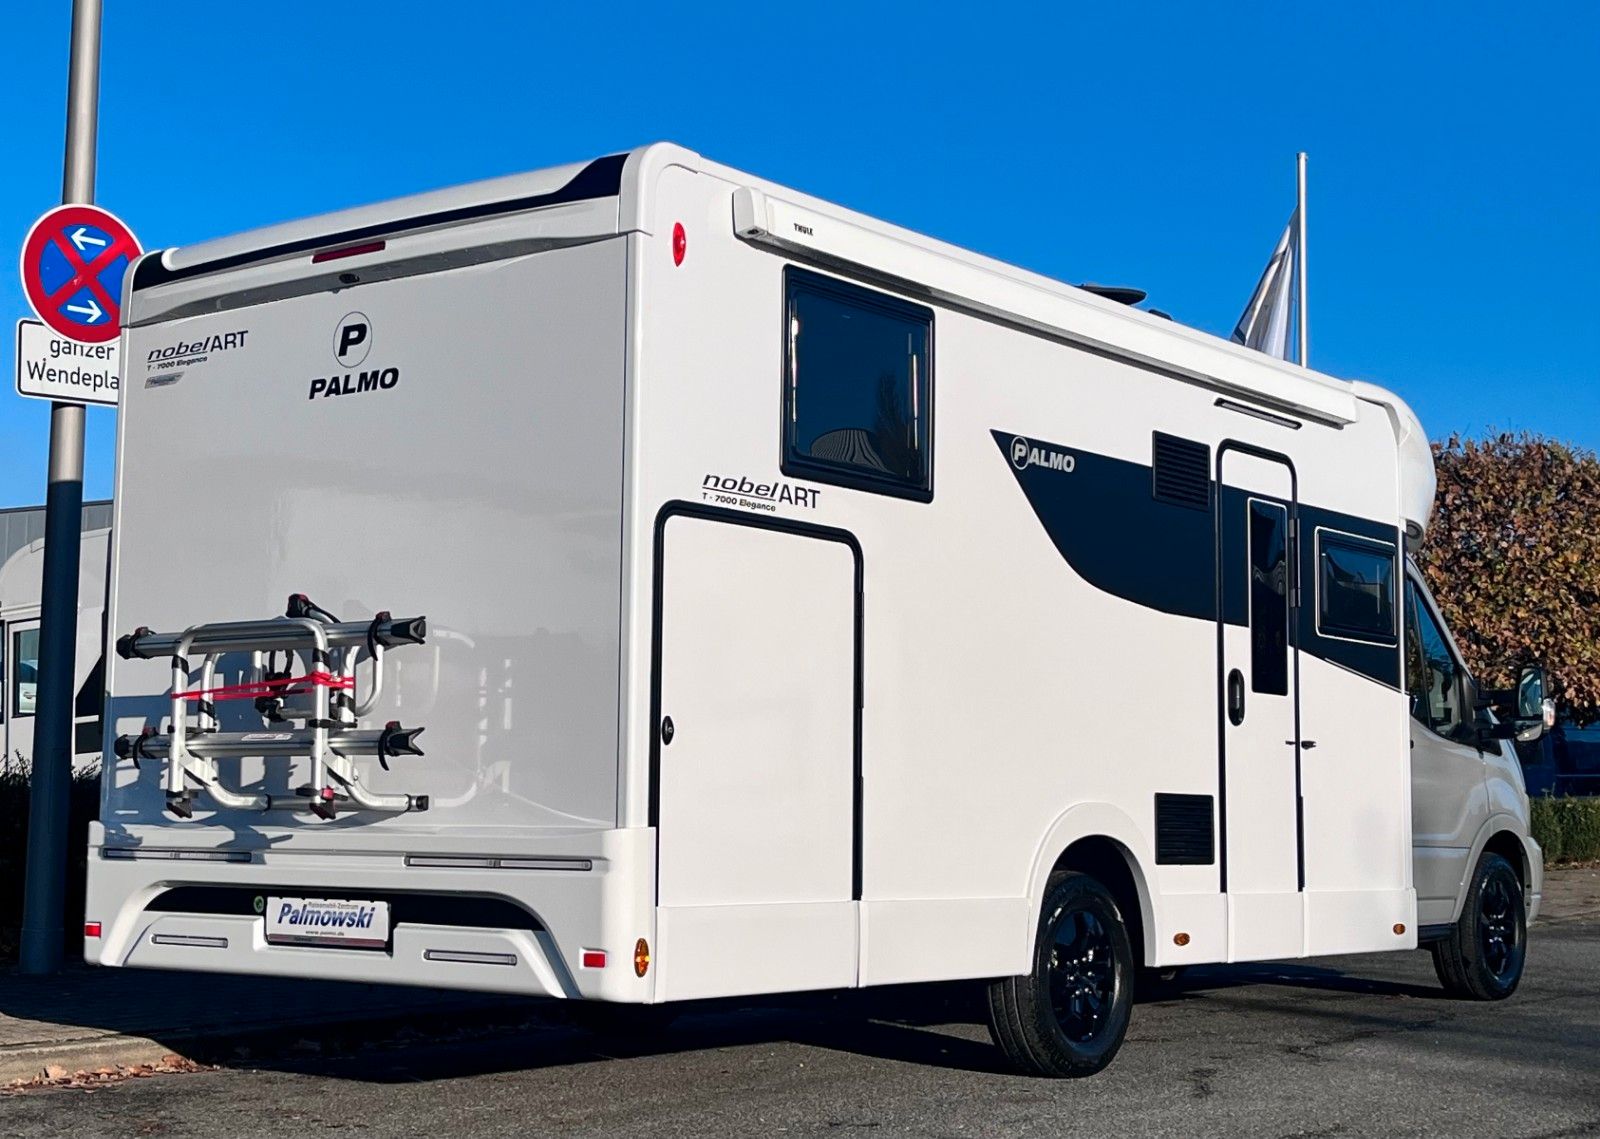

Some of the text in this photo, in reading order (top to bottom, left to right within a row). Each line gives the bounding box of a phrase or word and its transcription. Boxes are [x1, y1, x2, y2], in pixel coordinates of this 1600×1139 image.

[50, 340, 115, 360] ganzer
[308, 367, 399, 400] PALMO
[1011, 436, 1075, 472] PALMO
[715, 494, 738, 505] 7000
[739, 499, 776, 512] Elegance
[277, 903, 376, 929] Palmowski
